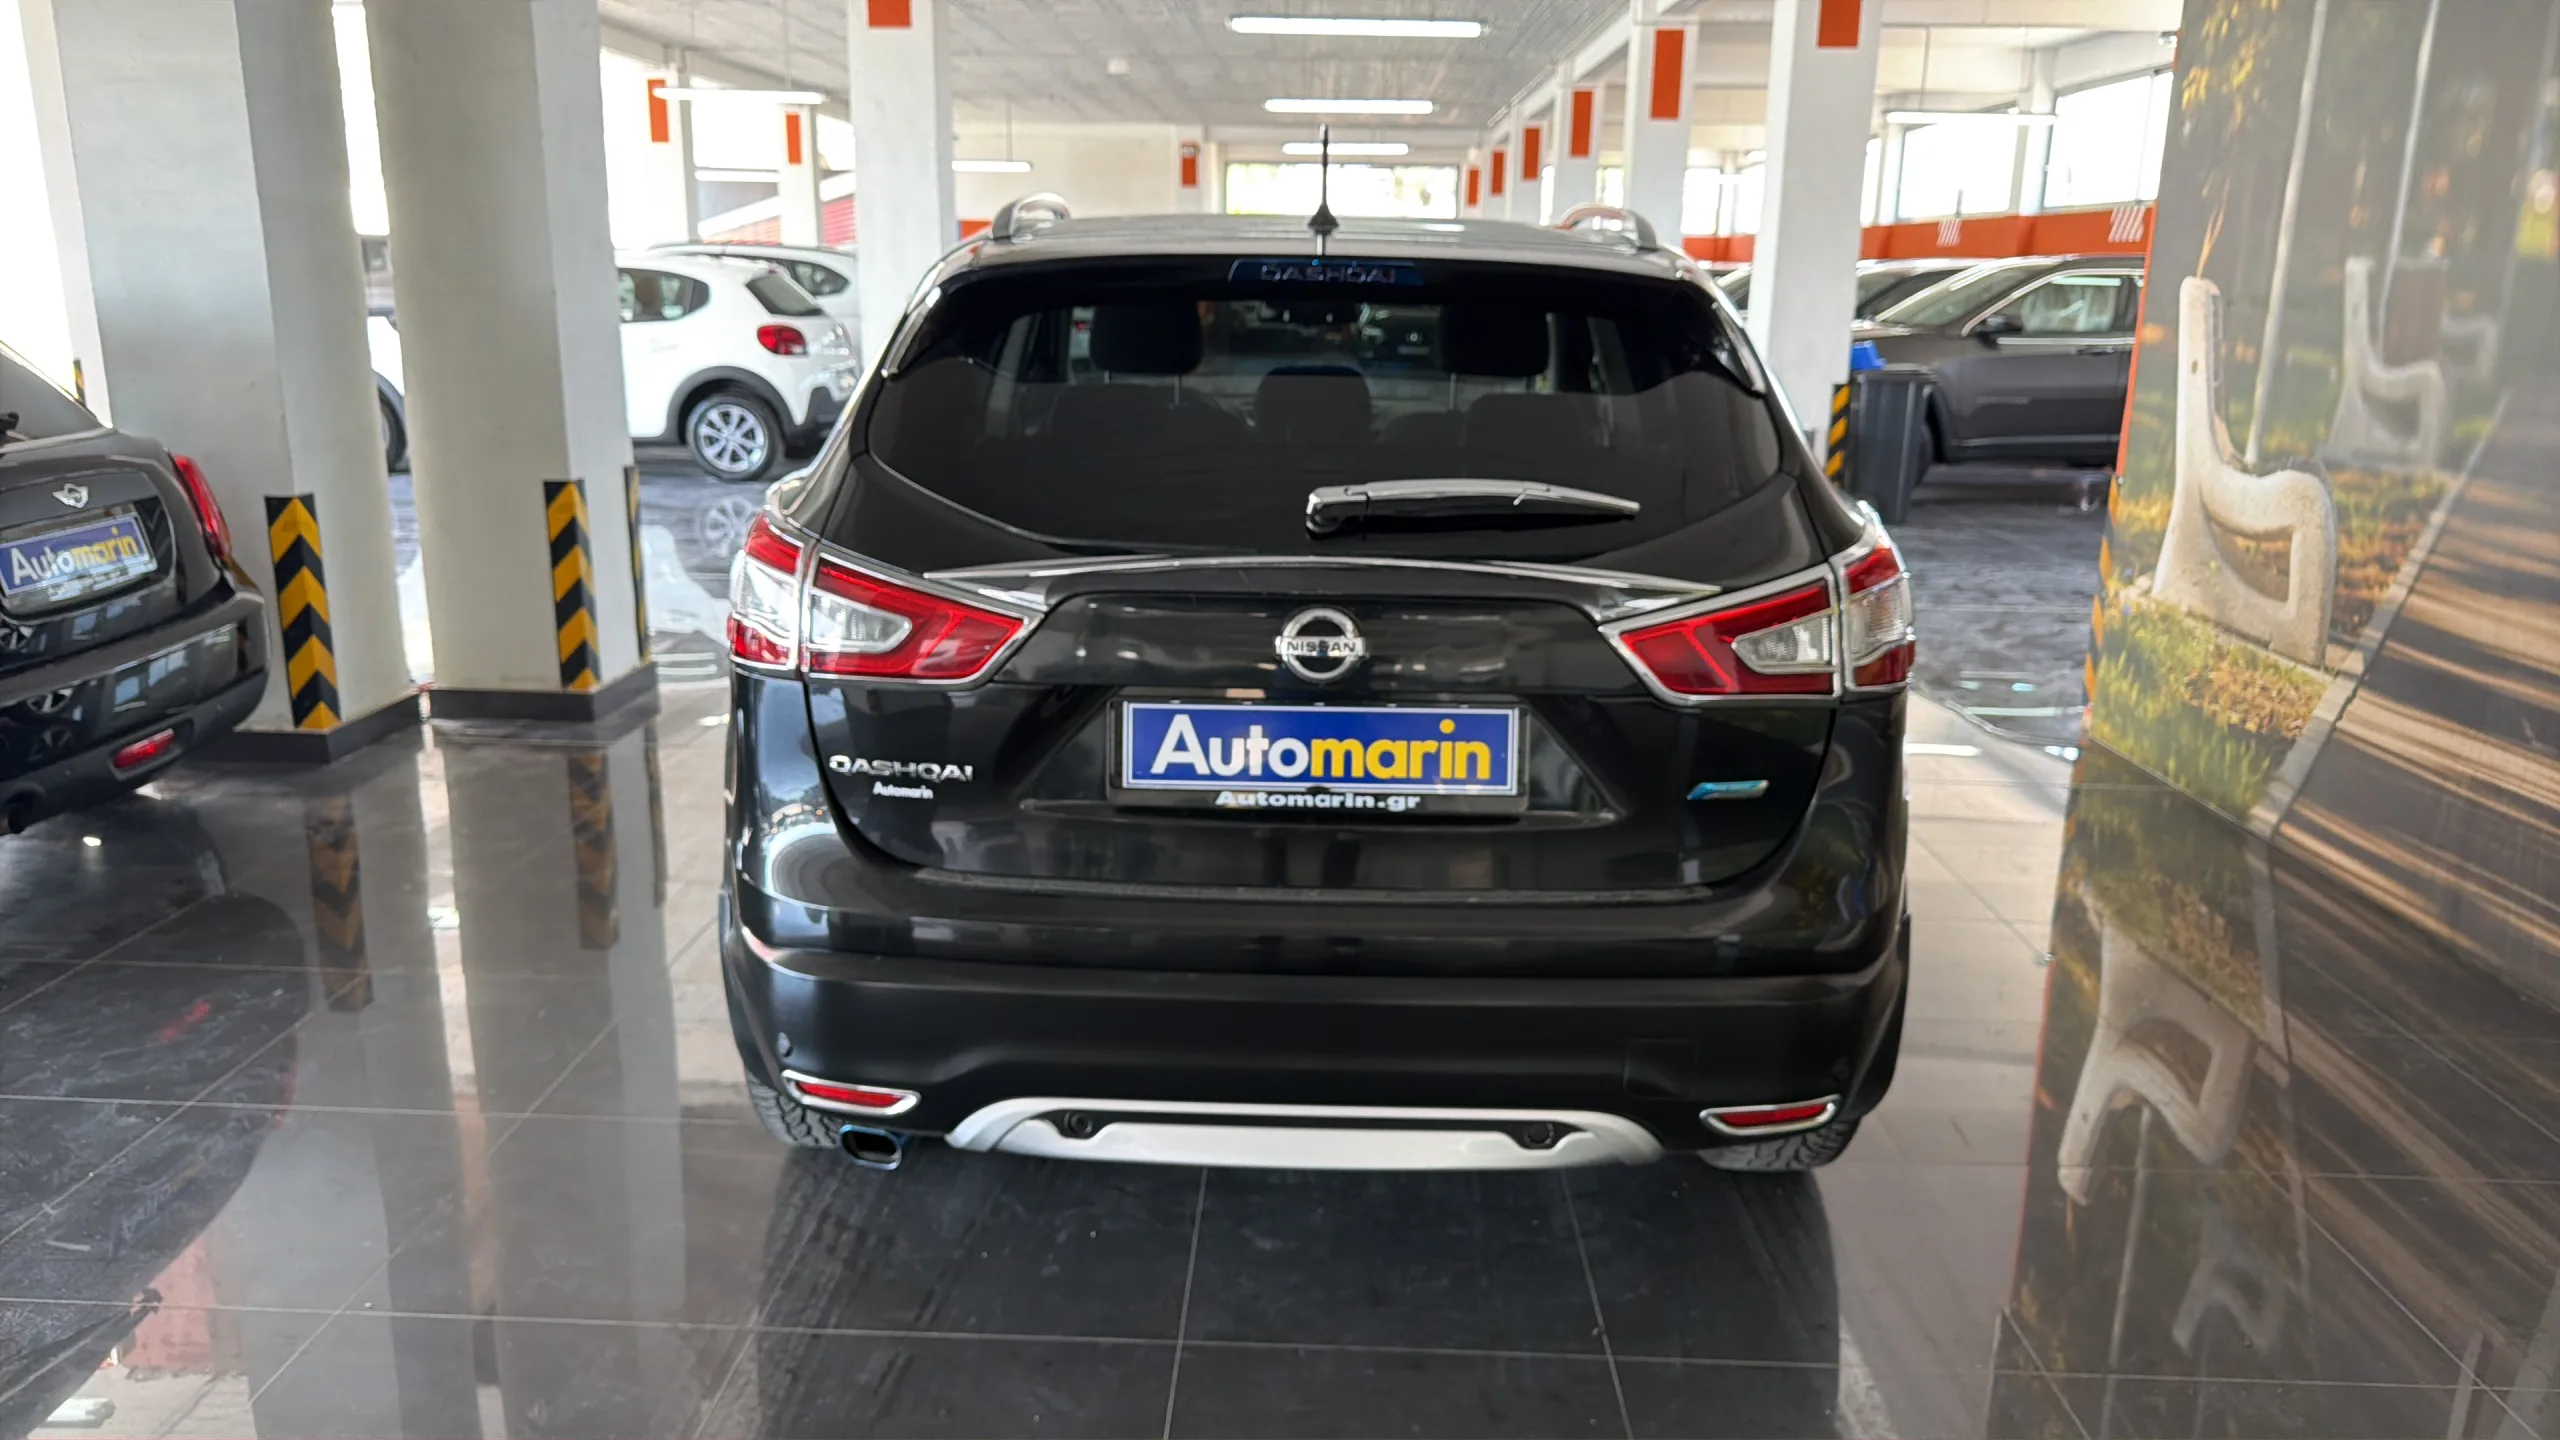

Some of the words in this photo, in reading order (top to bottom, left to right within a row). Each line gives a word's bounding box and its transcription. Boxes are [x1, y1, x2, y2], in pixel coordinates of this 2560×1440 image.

[10, 526, 140, 586] Automarin
[1286, 640, 1357, 654] NISSAN
[1150, 713, 1491, 780] Automarin
[829, 754, 974, 783] QASHQAI
[872, 780, 934, 800] Automarin
[1215, 790, 1422, 813] Automarin.gr
